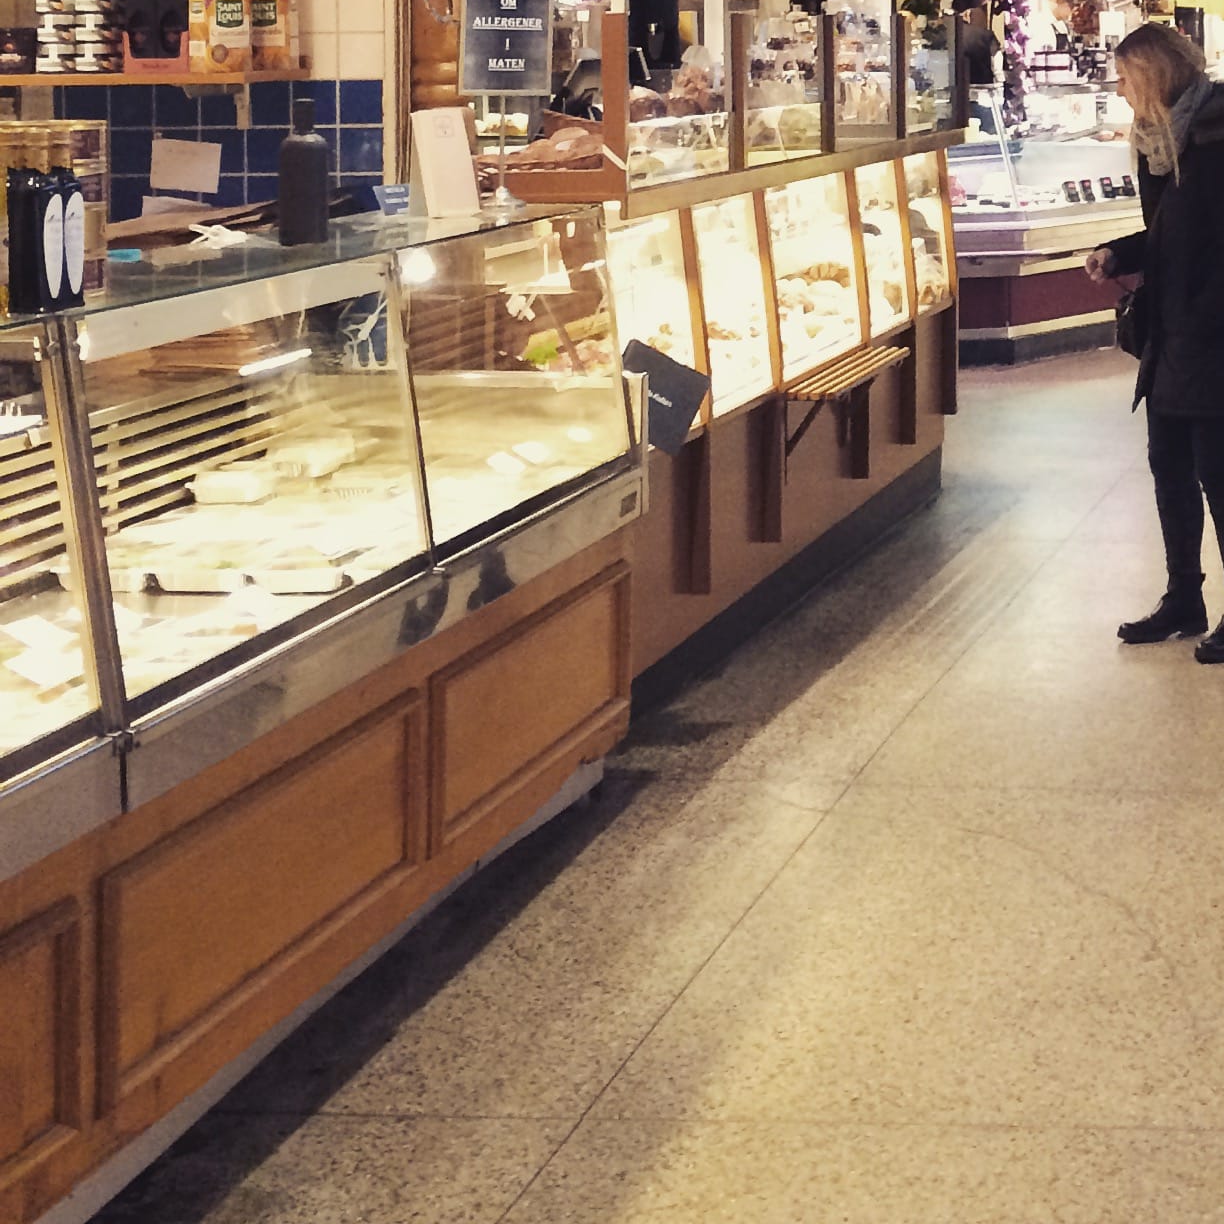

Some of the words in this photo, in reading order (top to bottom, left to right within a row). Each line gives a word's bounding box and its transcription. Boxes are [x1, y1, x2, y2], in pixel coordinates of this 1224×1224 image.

[217, 2, 242, 12] SAINT
[217, 10, 242, 24] LOUIS
[472, 16, 543, 29] ALLERGENER
[488, 58, 525, 70] MATEN
